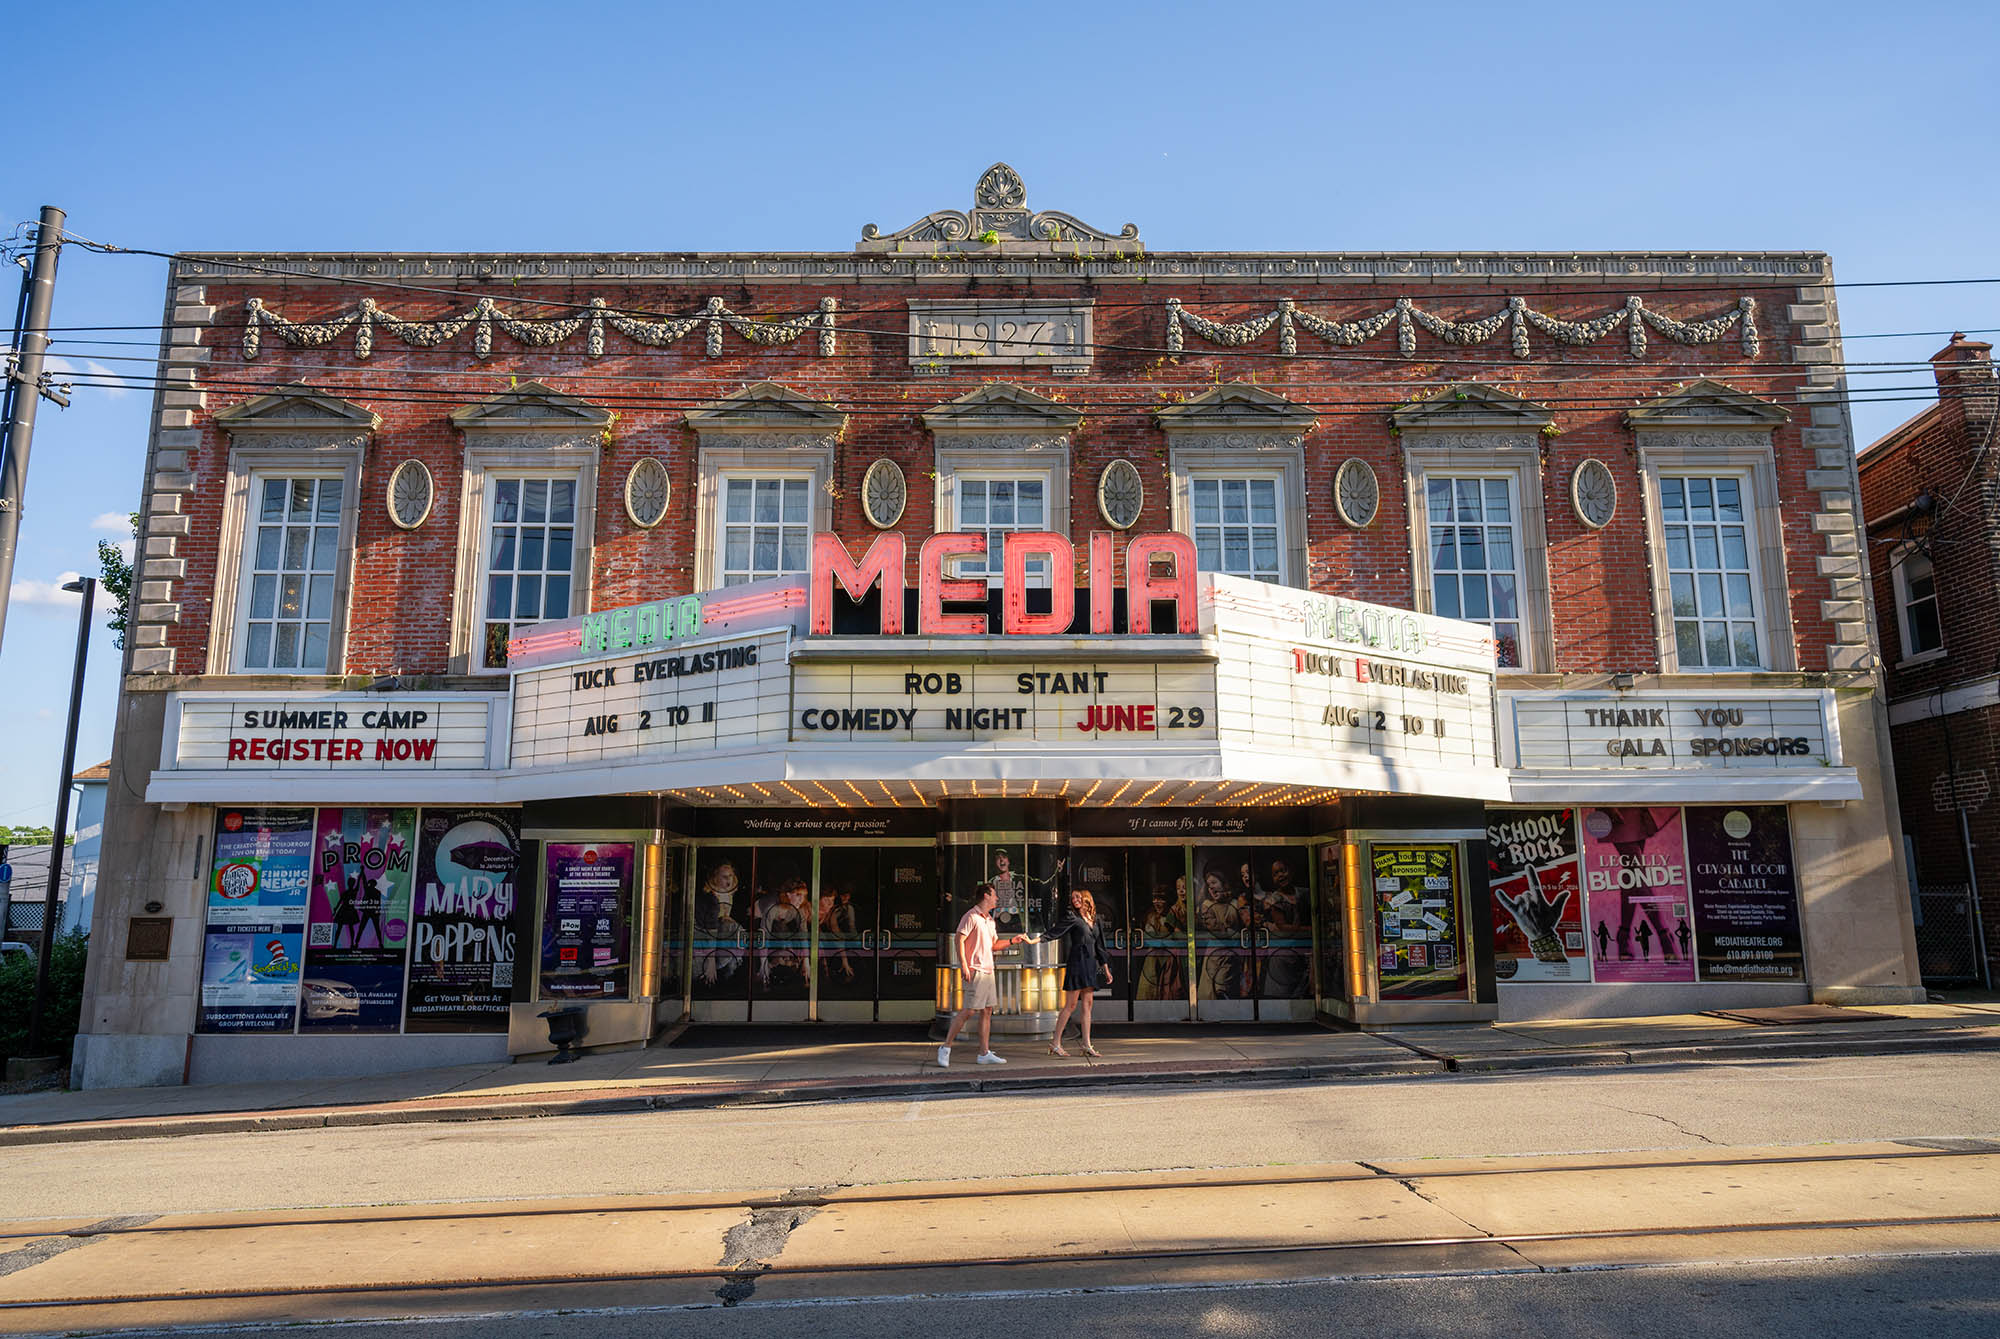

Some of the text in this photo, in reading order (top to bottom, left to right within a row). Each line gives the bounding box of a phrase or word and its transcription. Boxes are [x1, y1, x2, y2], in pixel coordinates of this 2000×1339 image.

[956, 322, 1047, 350] 1927
[810, 531, 1199, 635] MEDIA
[581, 597, 700, 654] MEDIA
[1303, 598, 1427, 654] MEDIA
[574, 646, 757, 691] TUCK EVERLASTING
[1292, 648, 1469, 694] TUCK EVERLASTING
[905, 671, 1109, 695] ROB STANT
[244, 710, 428, 729] SUMMER CAMP
[584, 714, 618, 736] AUG
[639, 710, 651, 730] 2
[666, 705, 689, 726] TO
[802, 704, 1206, 732] COMEDY NIGHT JUNE 29
[1322, 704, 1360, 727] AUG
[1375, 711, 1386, 731] 2
[1401, 714, 1425, 736] TO
[1585, 708, 1744, 728] THANK YOU
[227, 738, 437, 761] REGISTER NOW
[1606, 737, 1810, 757] GALA SPONSORS
[784, 819, 792, 828] is
[794, 819, 822, 828] serious
[825, 819, 850, 831] except
[1142, 818, 1147, 827] I
[1149, 818, 1177, 827] cannot
[1179, 817, 1195, 830] fly,
[1198, 817, 1208, 827] let
[1211, 819, 1222, 827] me
[1487, 814, 1566, 847] SCHOOL
[321, 842, 411, 873] PROM
[1376, 855, 1395, 867] THANK
[1508, 836, 1565, 865] ROCK
[1600, 854, 1670, 867] LEGALLY
[1731, 850, 1750, 860] THE
[261, 870, 309, 878] FINDING
[1588, 865, 1685, 891] BLONDE
[1697, 864, 1744, 875] CRYSTAL
[261, 877, 308, 888] NEMO
[1718, 878, 1766, 889] CABARET
[424, 876, 513, 920] MARY
[1715, 936, 1783, 946] MEDIATHEATRE.ORG
[1710, 964, 1793, 976] info@mediatheatre.org
